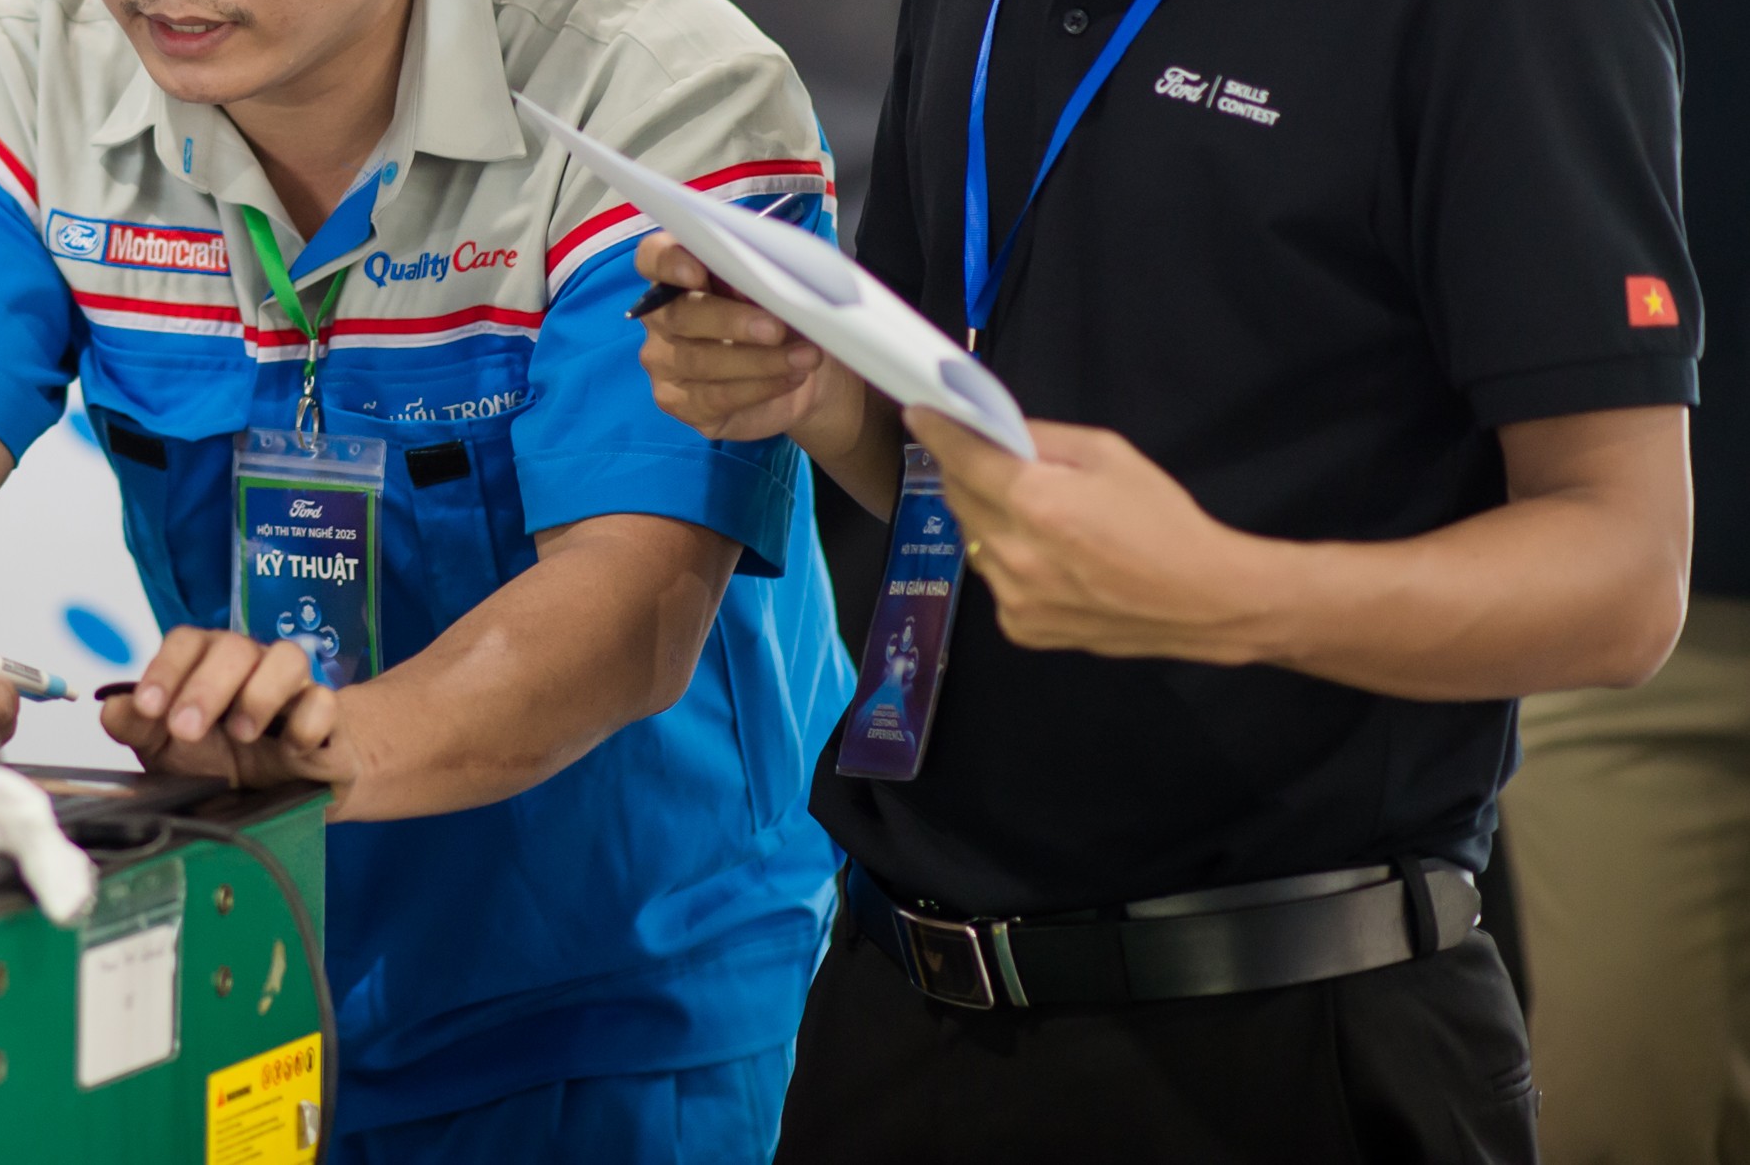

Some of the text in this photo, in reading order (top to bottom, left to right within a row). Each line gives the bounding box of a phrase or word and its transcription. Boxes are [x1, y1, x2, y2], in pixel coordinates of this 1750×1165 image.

[1155, 66, 1209, 103] Ford
[1223, 79, 1270, 104] SKILLS
[1217, 96, 1281, 126] CONTEST
[58, 223, 227, 268] Ford Motorcraft
[289, 499, 323, 519] Ford
[256, 523, 273, 537] HỘI
[274, 525, 289, 537] THI
[291, 526, 307, 538] TAY
[335, 529, 357, 540] 2025
[256, 549, 359, 586] KỸ THUẬT
